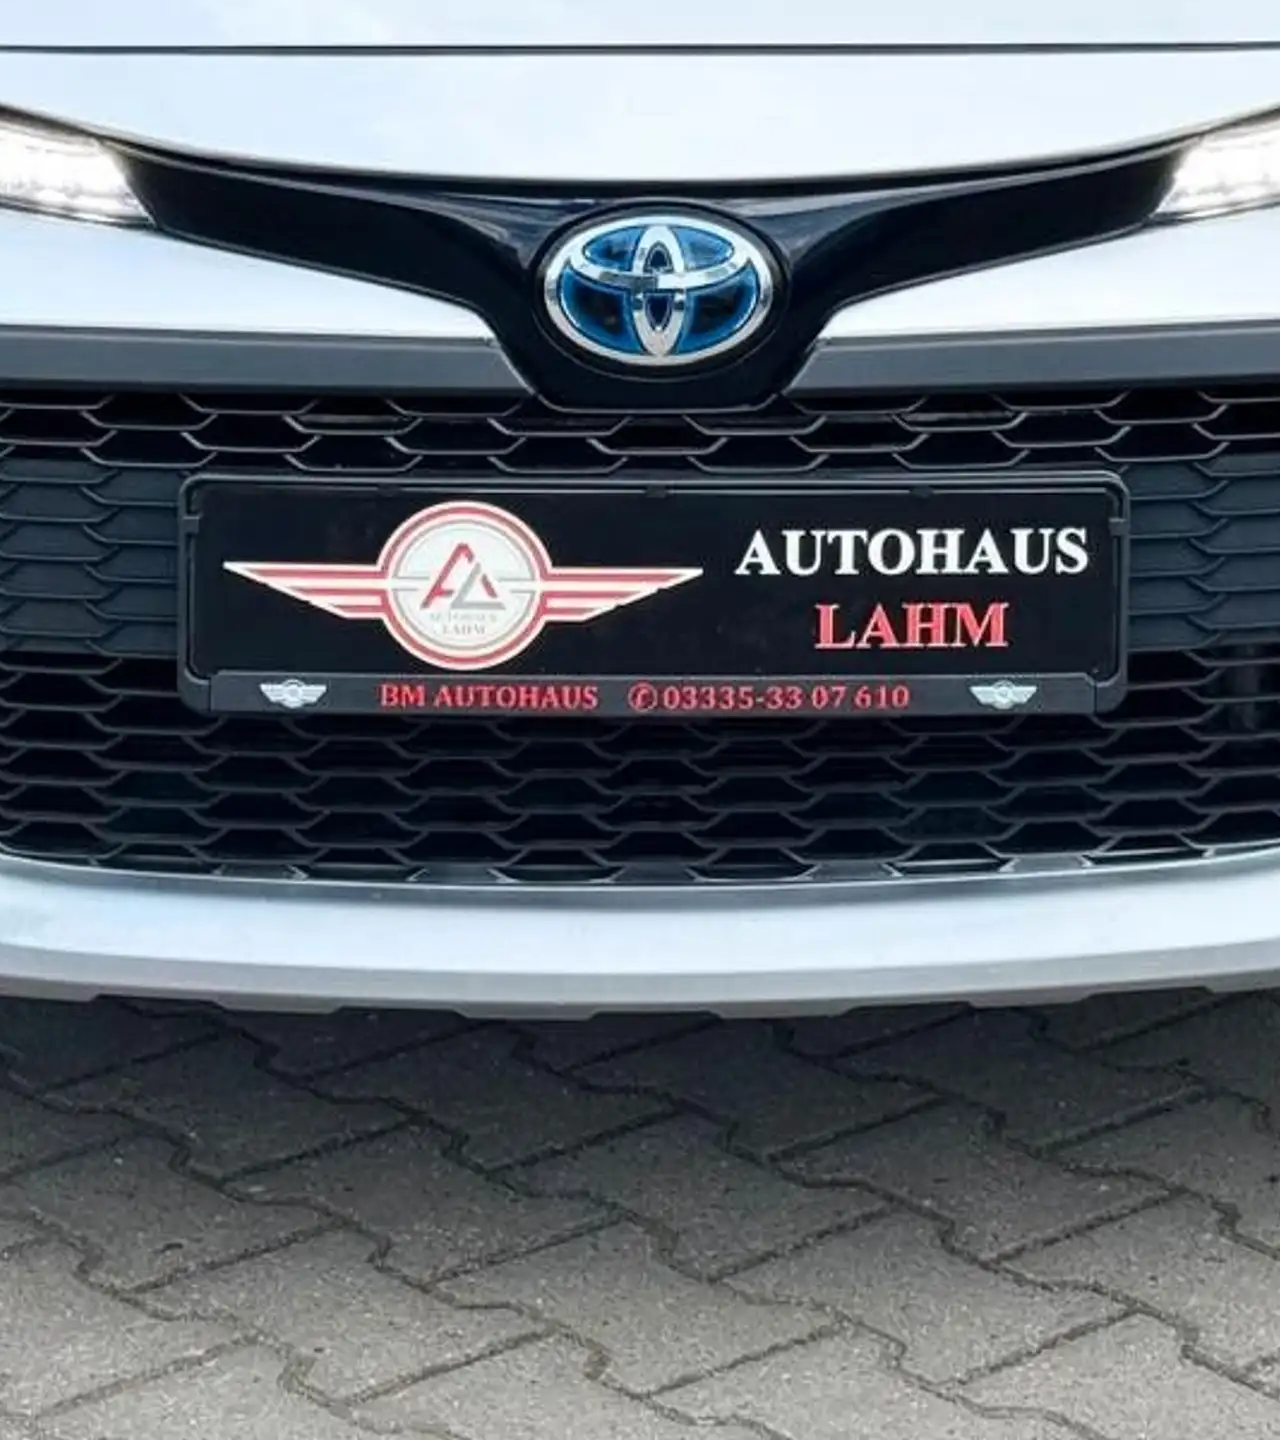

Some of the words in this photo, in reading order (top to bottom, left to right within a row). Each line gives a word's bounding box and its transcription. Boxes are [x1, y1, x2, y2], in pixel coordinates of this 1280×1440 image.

[733, 527, 1090, 576] AUTOHAUS
[814, 602, 1009, 649] LAHM
[380, 683, 425, 708] BM
[433, 685, 599, 710] AUTOHAUS
[854, 685, 910, 708] 610
